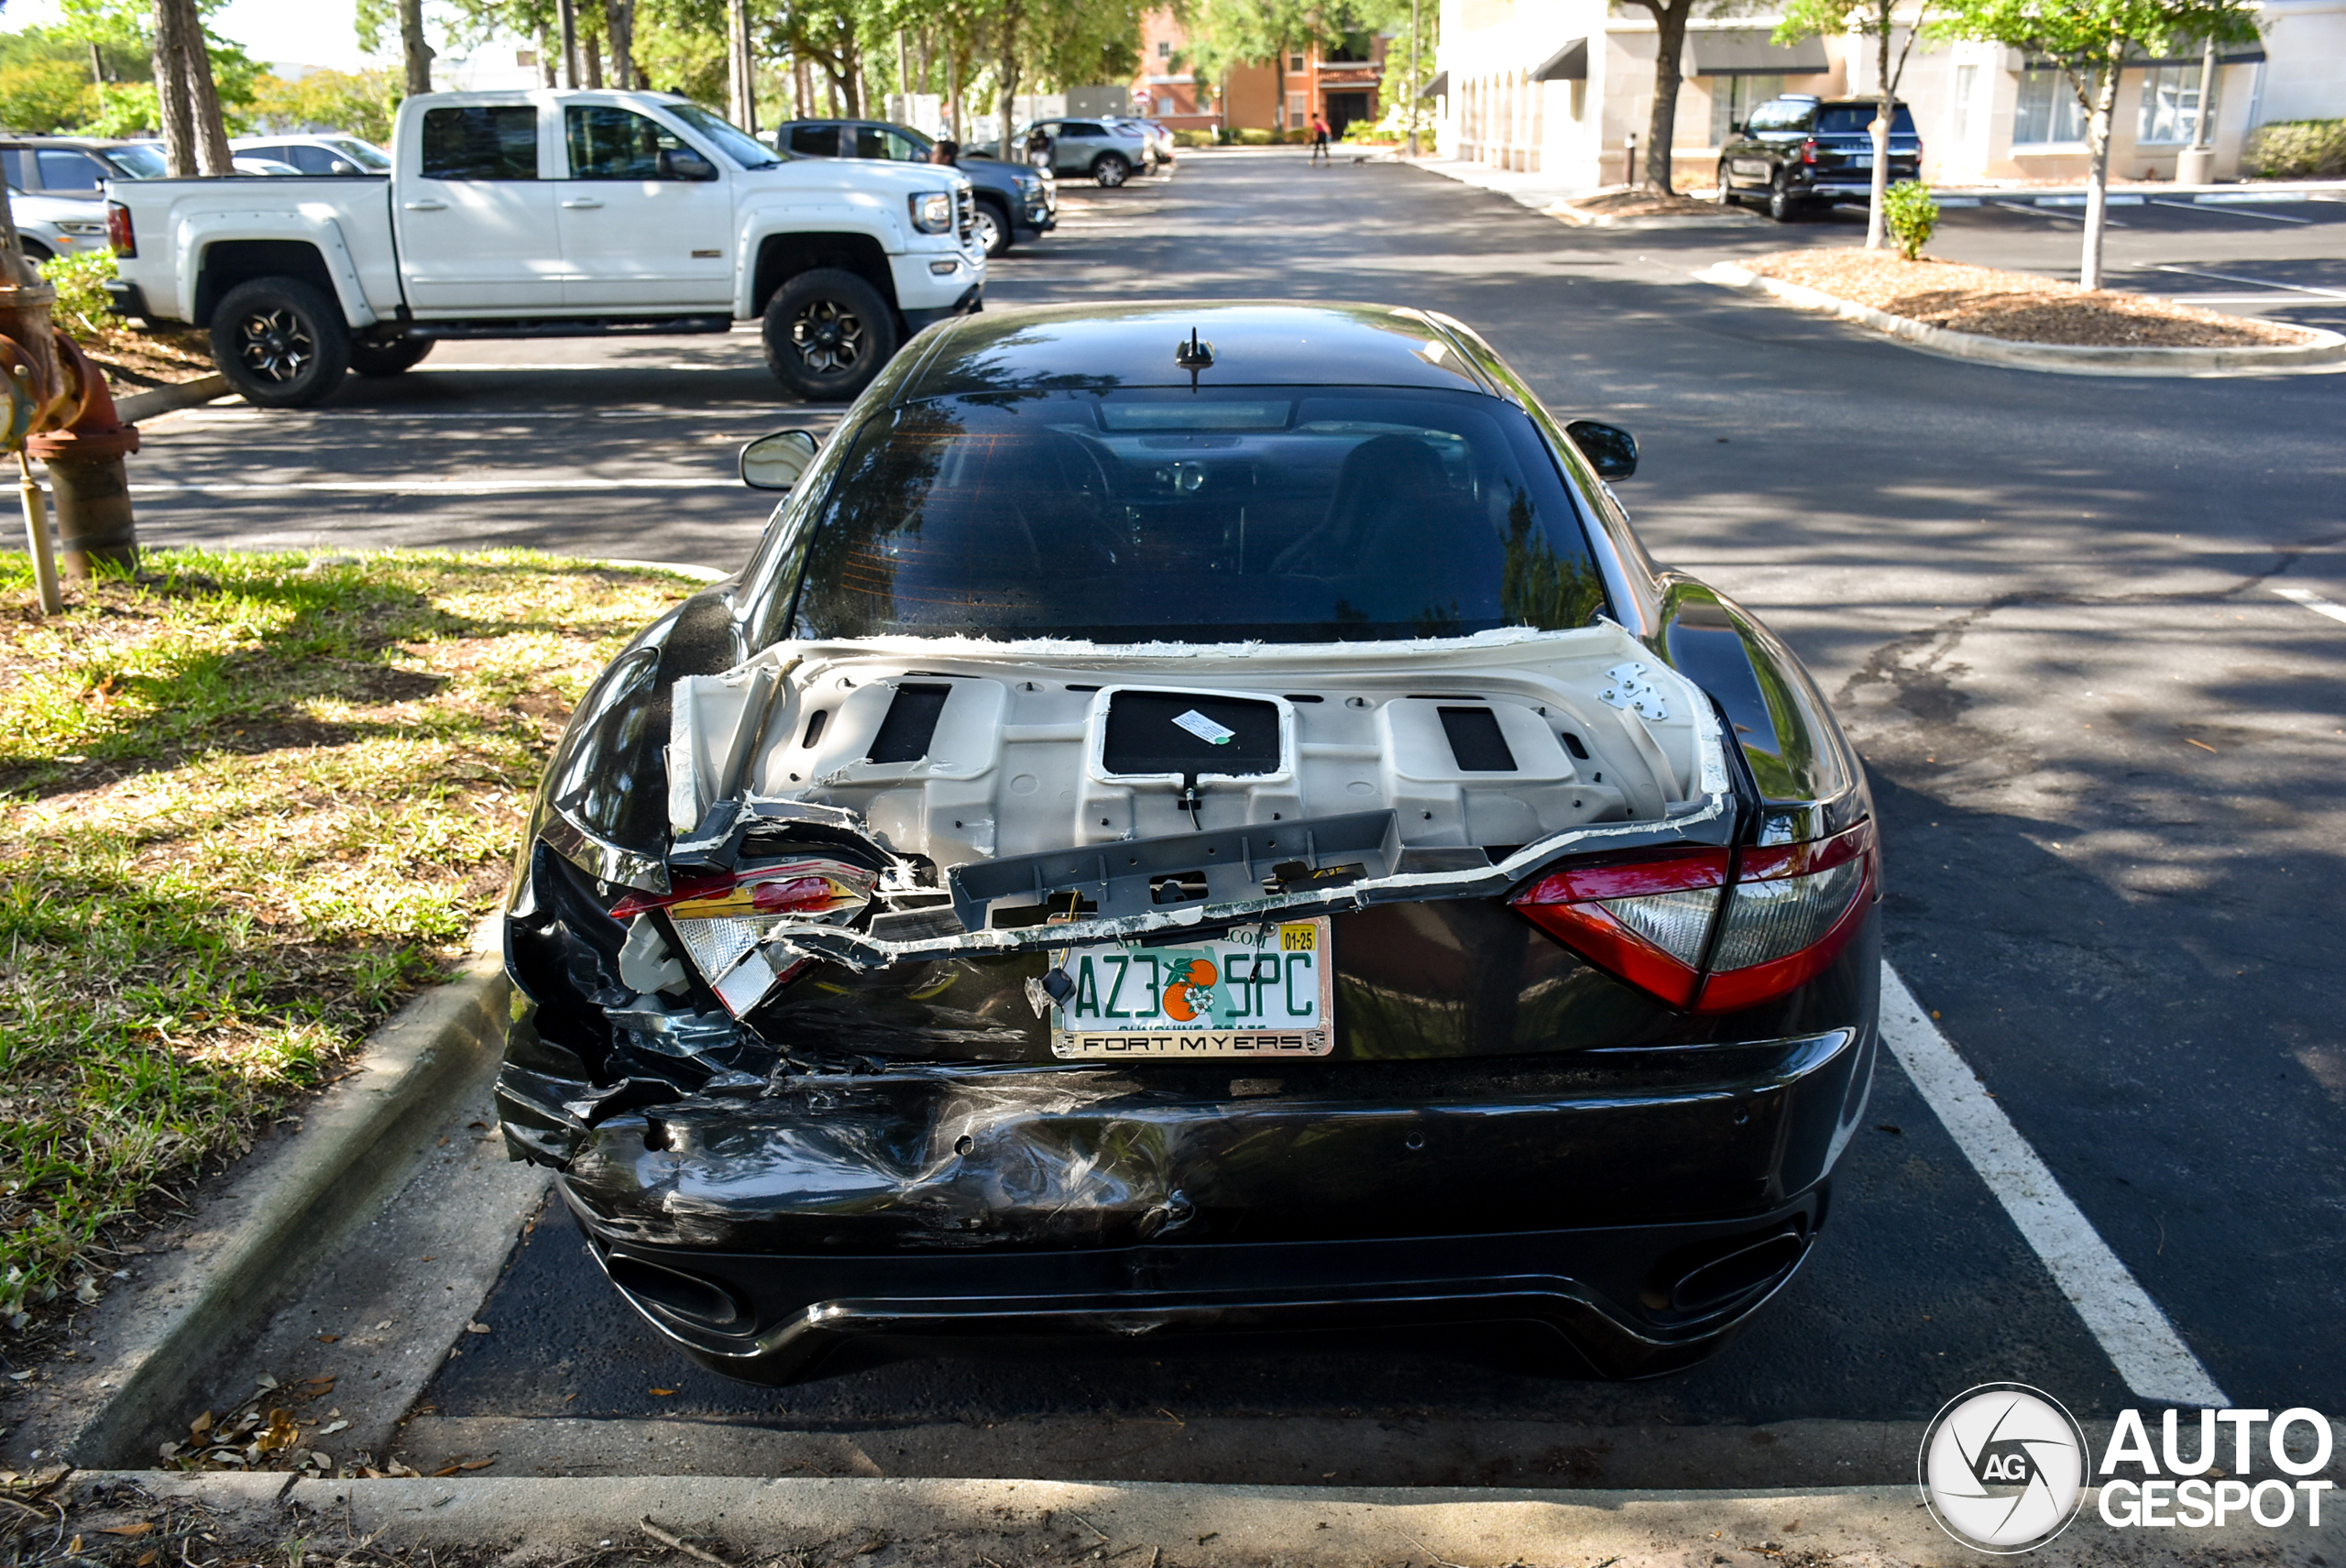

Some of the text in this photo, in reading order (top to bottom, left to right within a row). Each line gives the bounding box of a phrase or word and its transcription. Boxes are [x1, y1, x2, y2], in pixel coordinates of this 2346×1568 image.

[1285, 932, 1312, 949] 01-25
[1075, 955, 1160, 1017] AZ3
[1083, 1036, 1302, 1051] FORT MYERS
